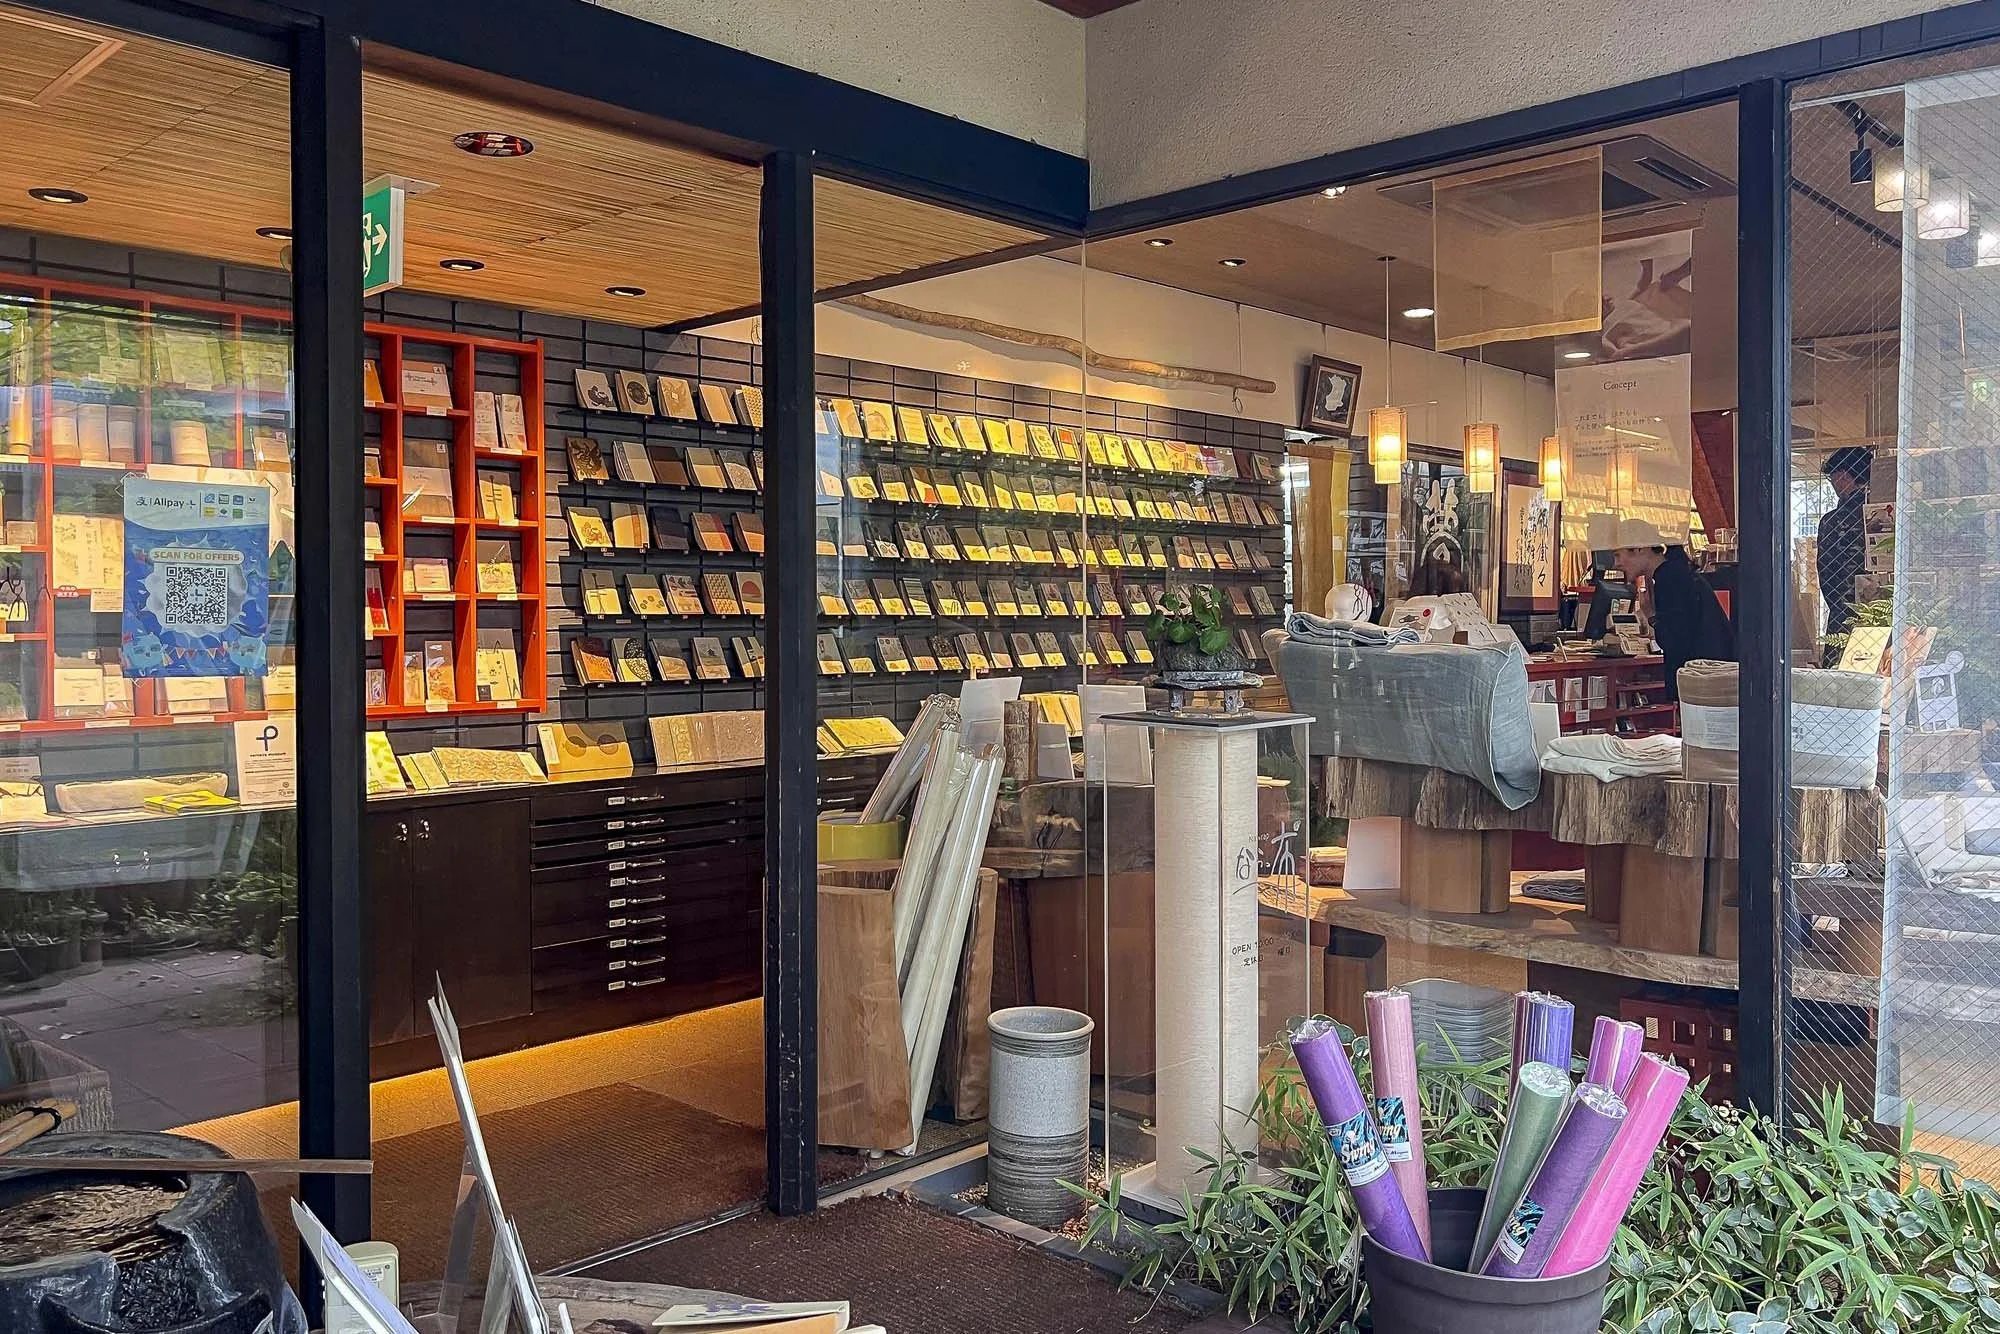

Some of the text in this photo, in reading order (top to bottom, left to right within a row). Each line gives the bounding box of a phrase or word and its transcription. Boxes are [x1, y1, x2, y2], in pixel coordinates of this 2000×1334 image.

[1603, 381, 1637, 391] Concept
[153, 550, 240, 561] SCAN FOR OFFERS
[1232, 943, 1252, 955] OPEN
